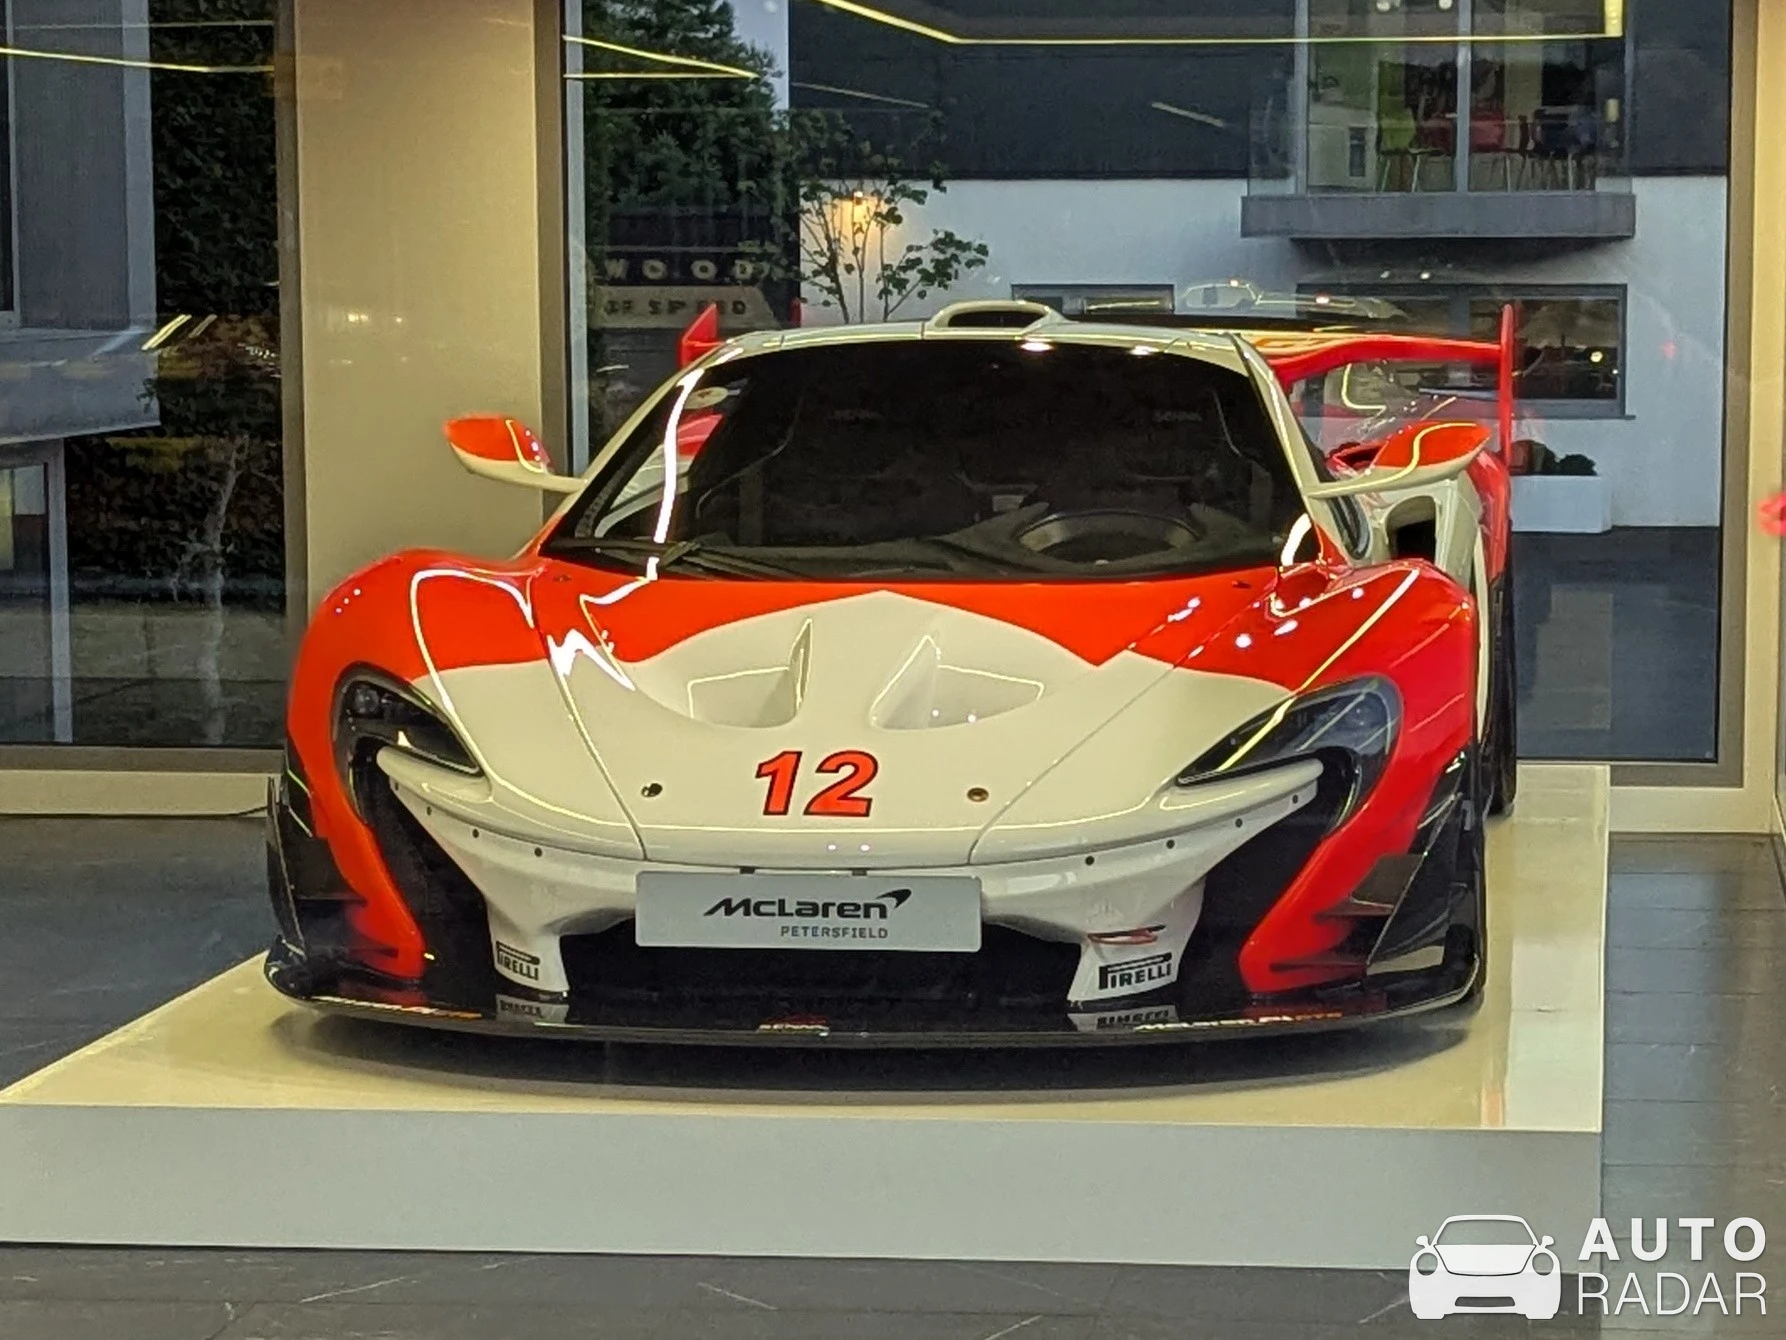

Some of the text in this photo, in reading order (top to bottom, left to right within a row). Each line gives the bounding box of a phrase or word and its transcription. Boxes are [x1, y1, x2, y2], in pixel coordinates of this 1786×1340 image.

[755, 750, 878, 818] 12
[703, 897, 889, 920] McLaren
[780, 925, 889, 939] PETERSFIELD
[495, 940, 541, 981] PIRELLI
[1098, 952, 1173, 990] PIRELLI
